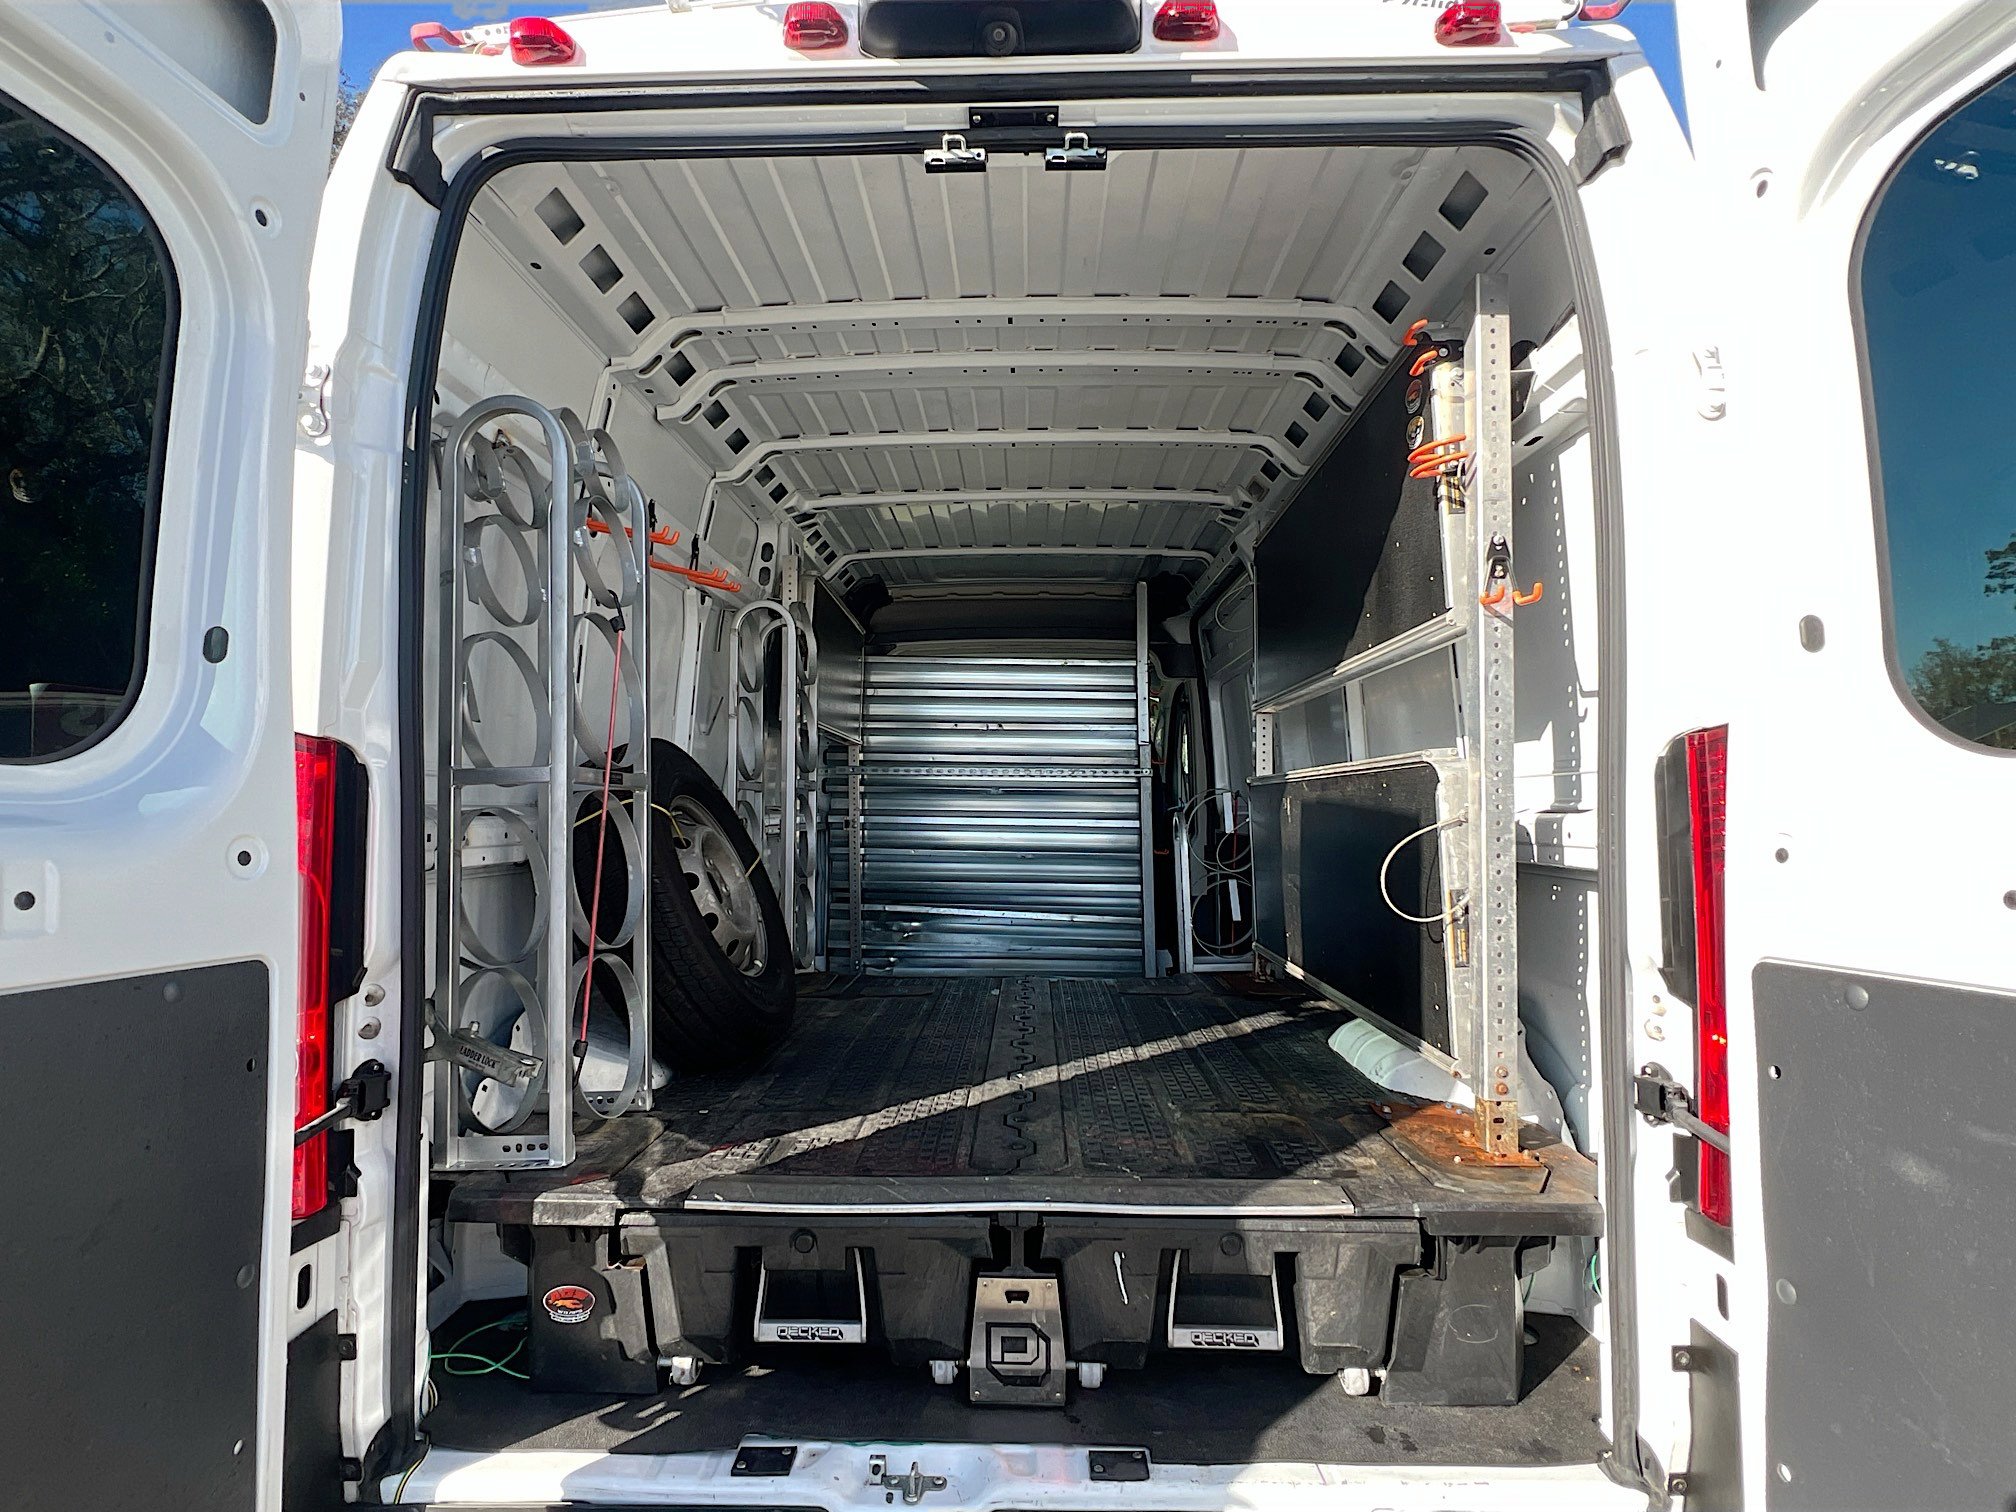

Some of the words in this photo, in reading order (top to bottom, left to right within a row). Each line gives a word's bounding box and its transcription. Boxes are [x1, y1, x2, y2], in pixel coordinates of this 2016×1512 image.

[460, 1046, 481, 1061] LADDER
[481, 1055, 496, 1069] LOCK
[777, 1326, 844, 1341] DECKED
[1190, 1331, 1260, 1348] DECKED
